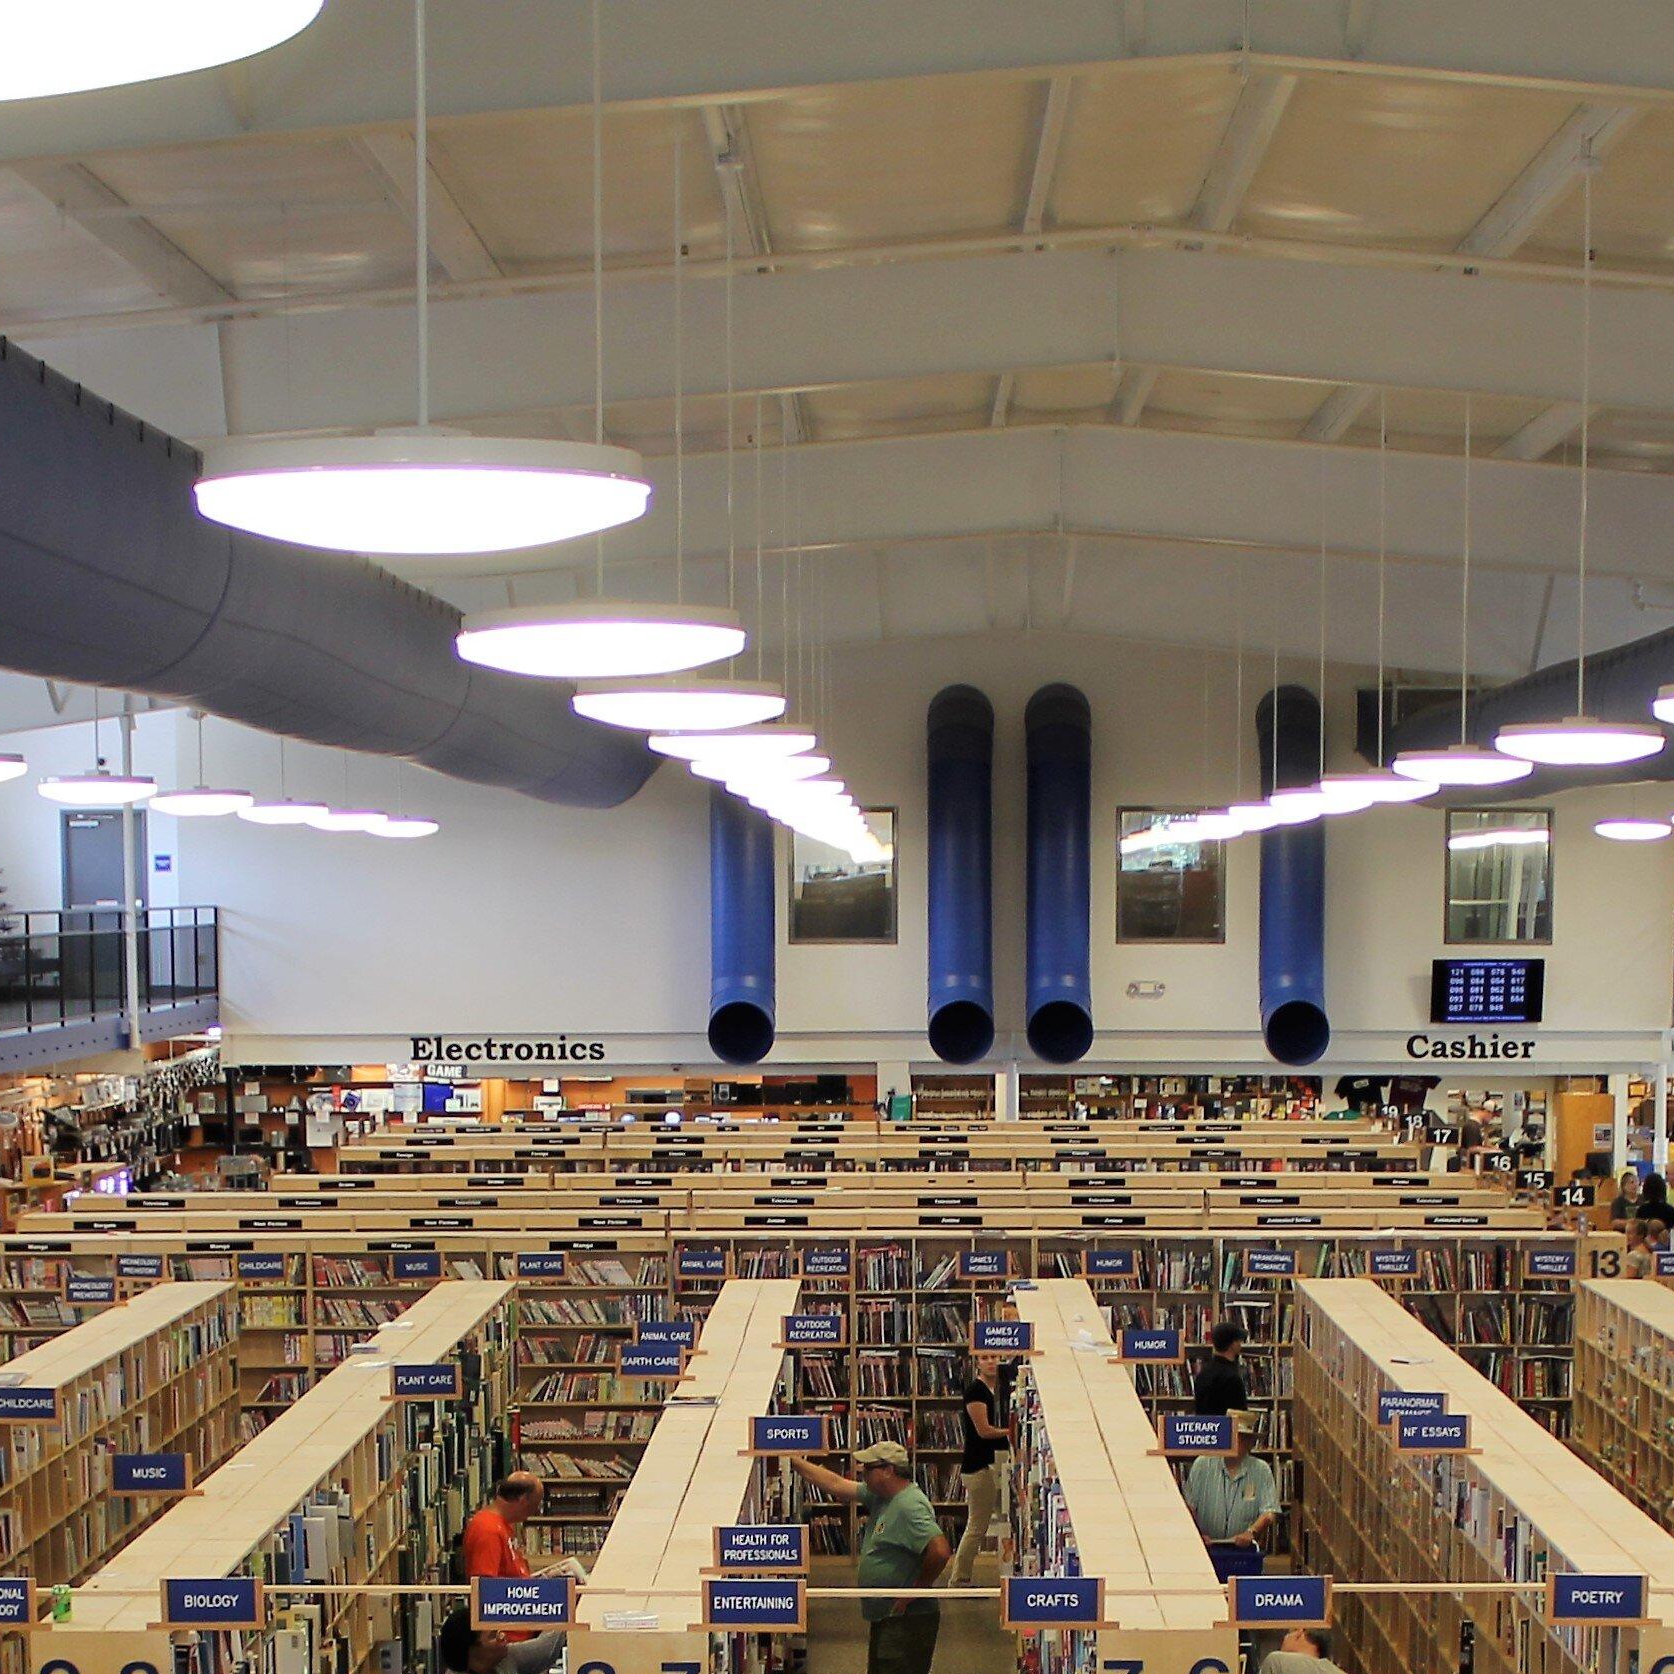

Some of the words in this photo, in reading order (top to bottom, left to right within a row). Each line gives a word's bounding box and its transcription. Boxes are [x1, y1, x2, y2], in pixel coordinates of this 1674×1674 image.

[409, 1034, 605, 1061] Electronics
[1406, 1033, 1536, 1059] Cashier
[427, 1065, 462, 1077] GAME
[1381, 1105, 1399, 1118] 19
[1405, 1114, 1422, 1128] 18
[1433, 1128, 1452, 1144] 17
[1491, 1155, 1511, 1171] 16
[1524, 1172, 1545, 1189] 15
[1560, 1188, 1585, 1205] 14
[1096, 1258, 1123, 1267] HUMOR
[1249, 1253, 1293, 1263] PARANORMAL
[1375, 1254, 1411, 1263] MYSTERY/
[1588, 1249, 1621, 1279] 13
[519, 1261, 542, 1270] PLANT
[543, 1261, 562, 1270] CARE
[1254, 1262, 1286, 1271] ROMANCE
[1377, 1263, 1409, 1272] THRILLER
[795, 1320, 832, 1330] OUTDOOR
[985, 1326, 1020, 1336] GAMES/
[640, 1331, 668, 1342] ANIMAL
[670, 1331, 691, 1342] CARE
[789, 1330, 837, 1340] RECREATION
[984, 1336, 1020, 1347] HOBBIES
[1134, 1339, 1167, 1350] HUMOR
[621, 1356, 652, 1367] EARTH
[654, 1356, 679, 1367] CARE
[397, 1375, 426, 1386] PLANT
[428, 1374, 453, 1386] CARE
[1380, 1396, 1440, 1409] PARANORMAL
[1175, 1421, 1221, 1433] LITERARY
[1403, 1426, 1419, 1437] NF
[1421, 1426, 1462, 1438] ESSAYS
[766, 1428, 809, 1440] SPORTS
[1178, 1434, 1218, 1445] STUDIES
[132, 1467, 167, 1479] MUSIC
[731, 1534, 767, 1546] HEALTH
[770, 1533, 790, 1546] FOR
[723, 1548, 798, 1561] PROFESSIONALS
[507, 1586, 540, 1599] HOME
[1571, 1590, 1624, 1604] POETRY
[183, 1594, 239, 1608] BIOLOGY
[713, 1595, 794, 1610] ENTERTAINING
[1026, 1593, 1079, 1607] CRAFTS
[1255, 1593, 1304, 1607] DRAMA
[483, 1602, 564, 1616] IMPROVEMENT
